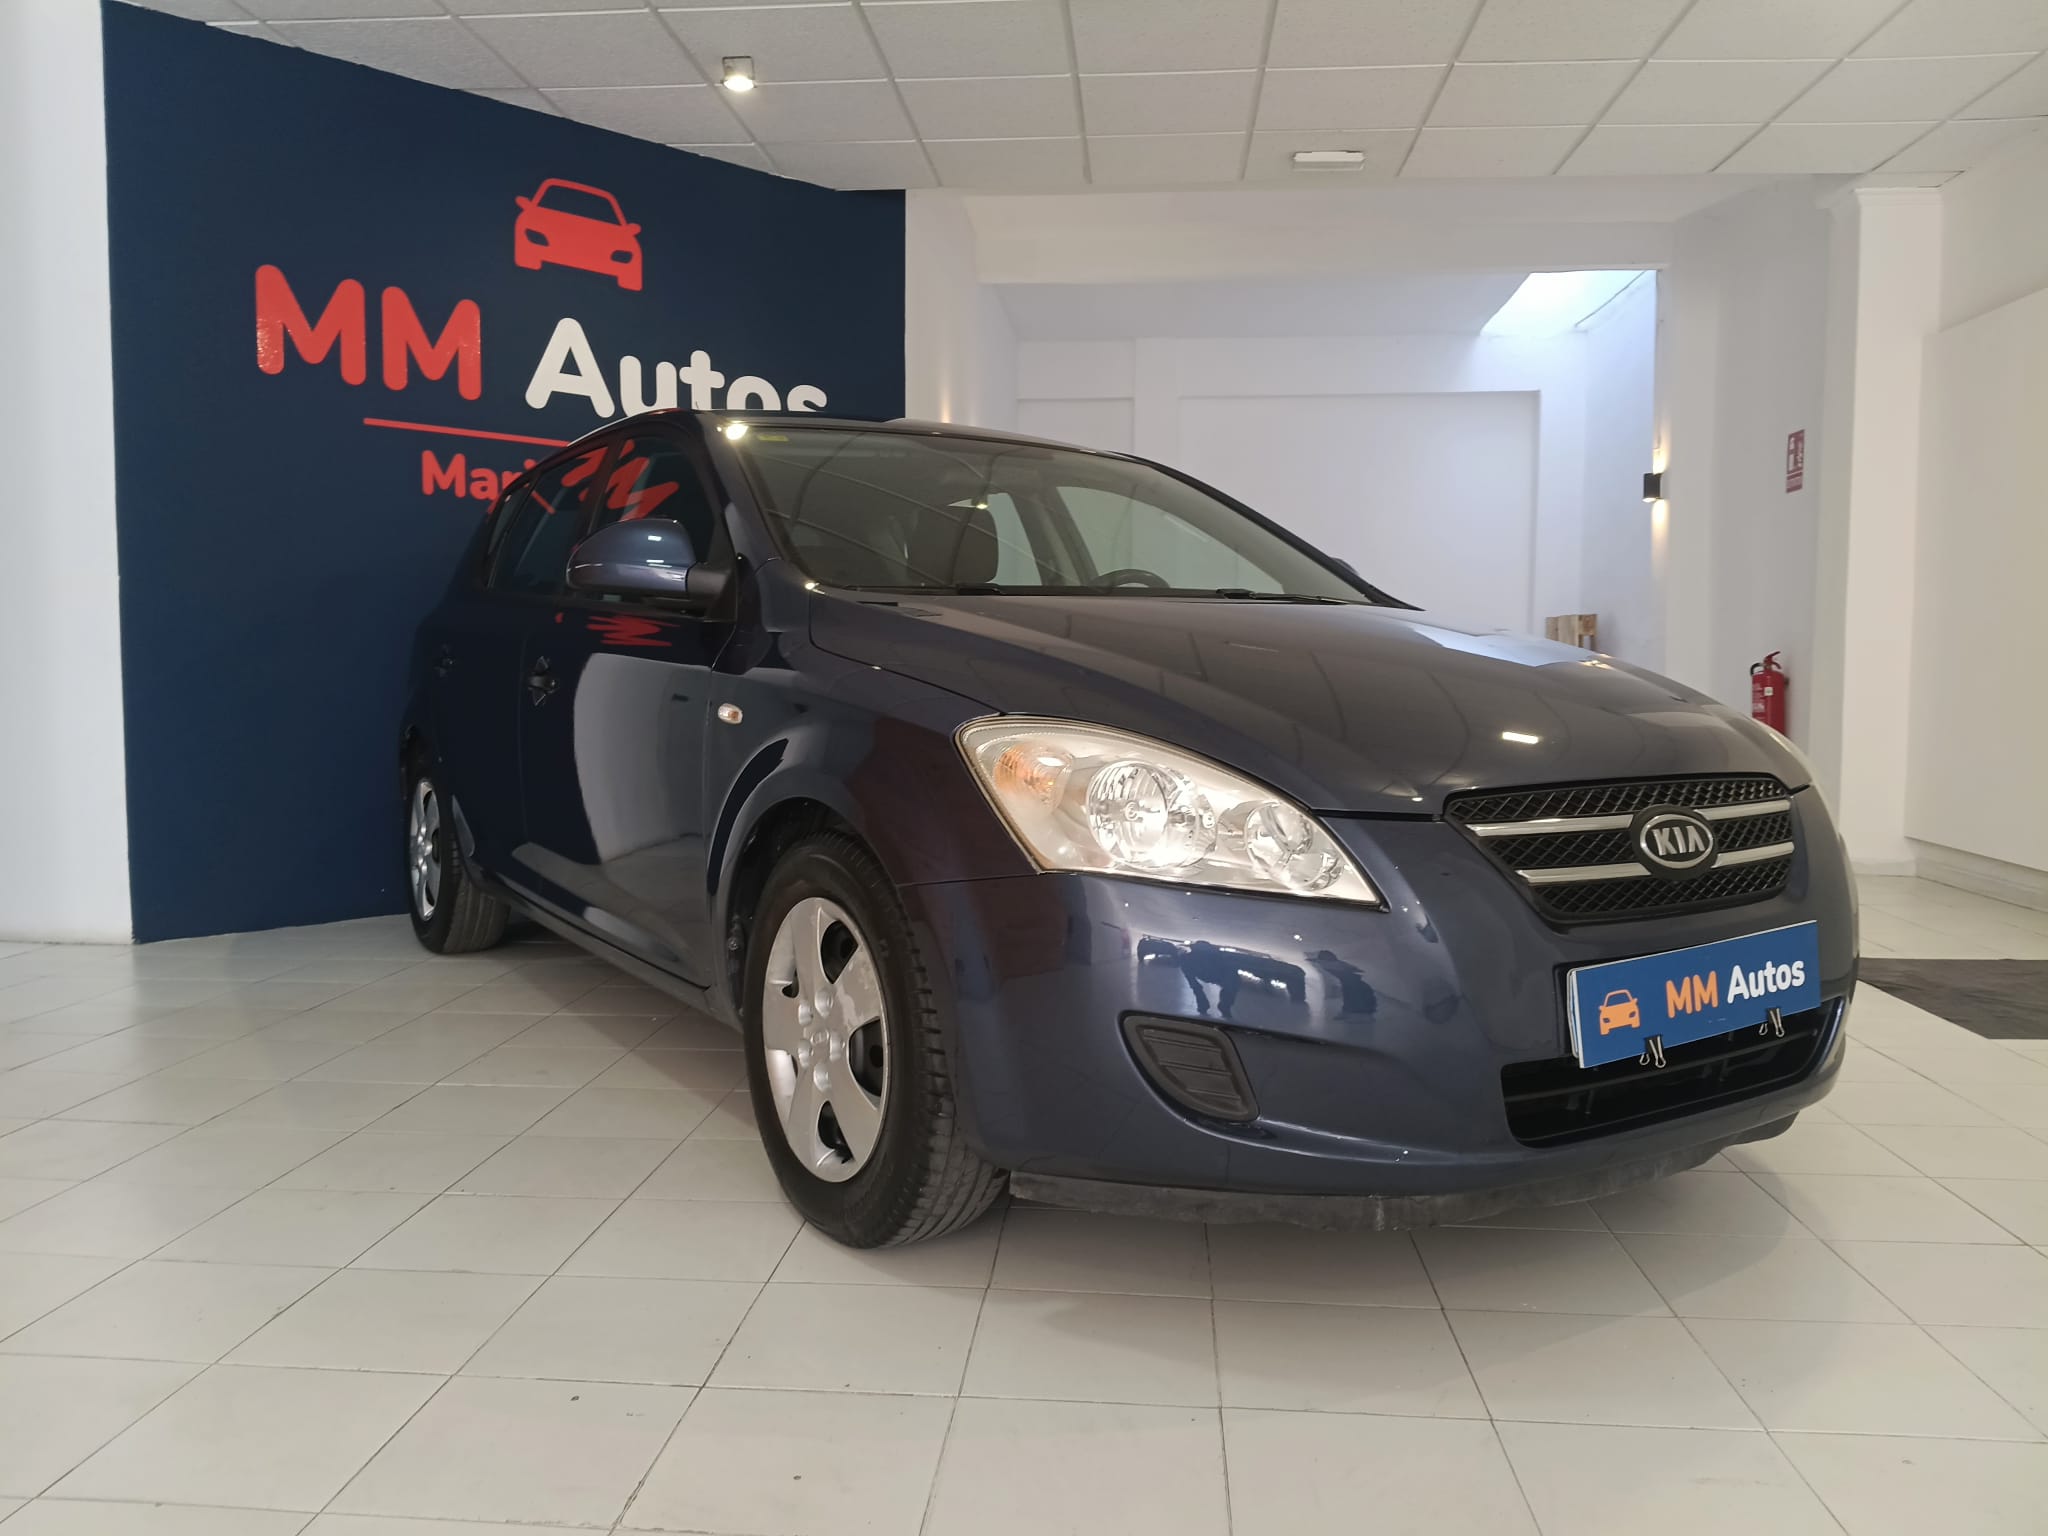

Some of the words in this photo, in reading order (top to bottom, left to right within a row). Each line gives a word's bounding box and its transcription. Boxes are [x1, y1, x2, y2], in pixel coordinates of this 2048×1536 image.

[255, 264, 482, 401] MM
[1652, 825, 1706, 856] KIA
[1665, 970, 1719, 1019] MM
[1727, 960, 1806, 1004] Autos
